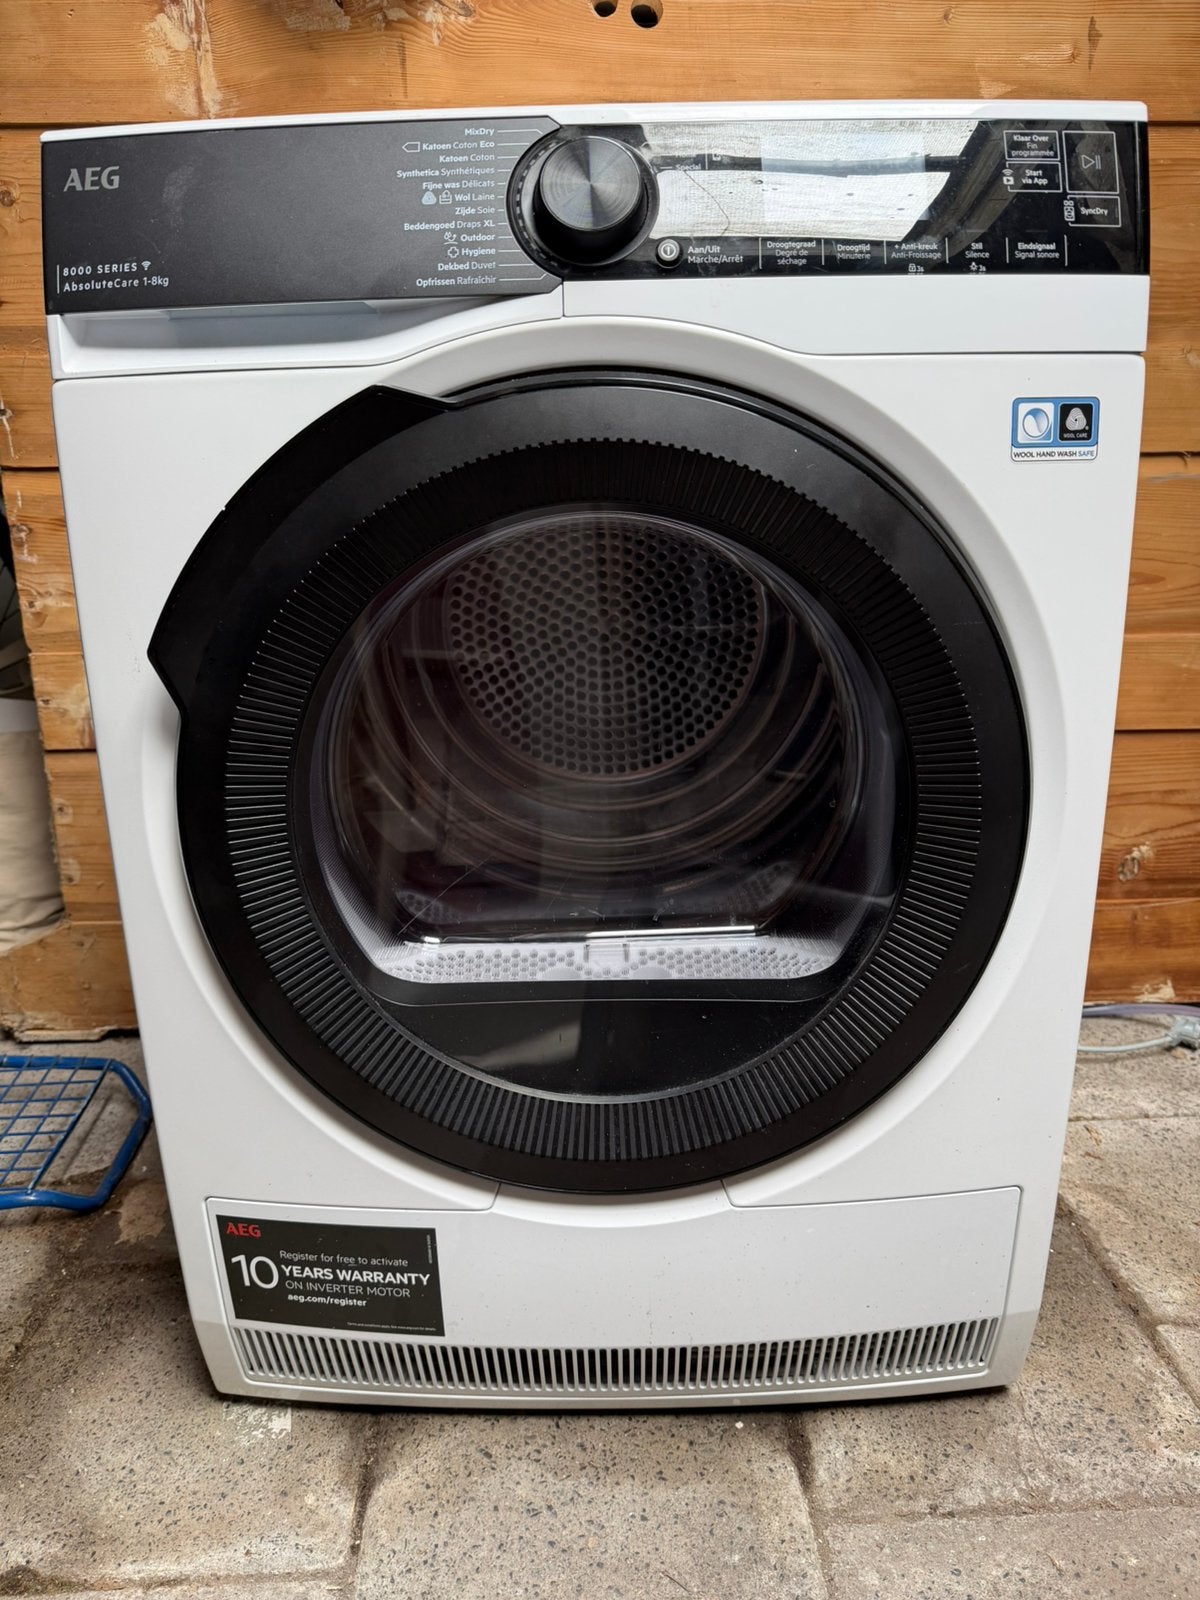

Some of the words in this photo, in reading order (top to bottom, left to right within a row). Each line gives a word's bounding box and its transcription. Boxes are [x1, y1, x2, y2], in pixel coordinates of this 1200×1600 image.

[464, 128, 495, 136] MixDry
[422, 142, 451, 151] Katoen
[1011, 149, 1055, 157] programmée
[439, 155, 469, 163] Katoen
[396, 169, 440, 179] Synthetica
[441, 166, 495, 176] Synthétiques
[1025, 169, 1043, 177] Start
[63, 165, 120, 192] AEG
[1034, 177, 1048, 185] App
[422, 181, 443, 191] Fijne
[462, 180, 495, 188] Délicats
[455, 193, 471, 201] Wol
[472, 192, 495, 200] Laine
[455, 206, 476, 216] Zijde
[477, 206, 495, 214] Soie
[1080, 207, 1108, 216] SyncDry
[404, 220, 455, 231] Beddengoed
[457, 220, 481, 229] Draps
[460, 233, 495, 241] Outdoor
[766, 240, 816, 249] Droogtegraad
[837, 243, 871, 253] Droogtijd
[901, 242, 938, 250] Anti-kreuk
[970, 242, 983, 250] Stil
[1018, 242, 1056, 251] Eindsignaal
[461, 247, 496, 257] Hygiene
[688, 245, 721, 254] Aan/Uit
[775, 249, 797, 258] Degré
[799, 249, 808, 257] de
[837, 252, 871, 260] Minuterie
[891, 251, 942, 260] Anti-Froissage
[965, 250, 990, 259] Silence
[1014, 251, 1036, 259] Signal
[688, 255, 743, 264] Marche/Arrêt
[777, 257, 807, 266] séchage
[63, 265, 92, 277] 8000
[97, 262, 138, 274] SERIES
[438, 262, 470, 271] Dekbed
[471, 261, 496, 269] Duvet
[63, 278, 140, 292] AbsoluteCare
[143, 275, 169, 287] 1-8kg
[416, 278, 455, 288] Opfrissen
[457, 276, 496, 285] Rafraîchir
[225, 1222, 262, 1238] AEG
[279, 1250, 319, 1263] Register
[320, 1252, 335, 1263] for
[336, 1254, 356, 1265] free
[357, 1256, 368, 1266] to
[370, 1257, 409, 1267] activate
[230, 1254, 280, 1290] 10
[280, 1264, 334, 1281] YEARS
[336, 1269, 431, 1287] WARRANTY
[285, 1280, 303, 1290] ON
[306, 1282, 364, 1295] INVERTER
[367, 1286, 411, 1298] MOTOR
[287, 1294, 367, 1307] aeg.com/register
